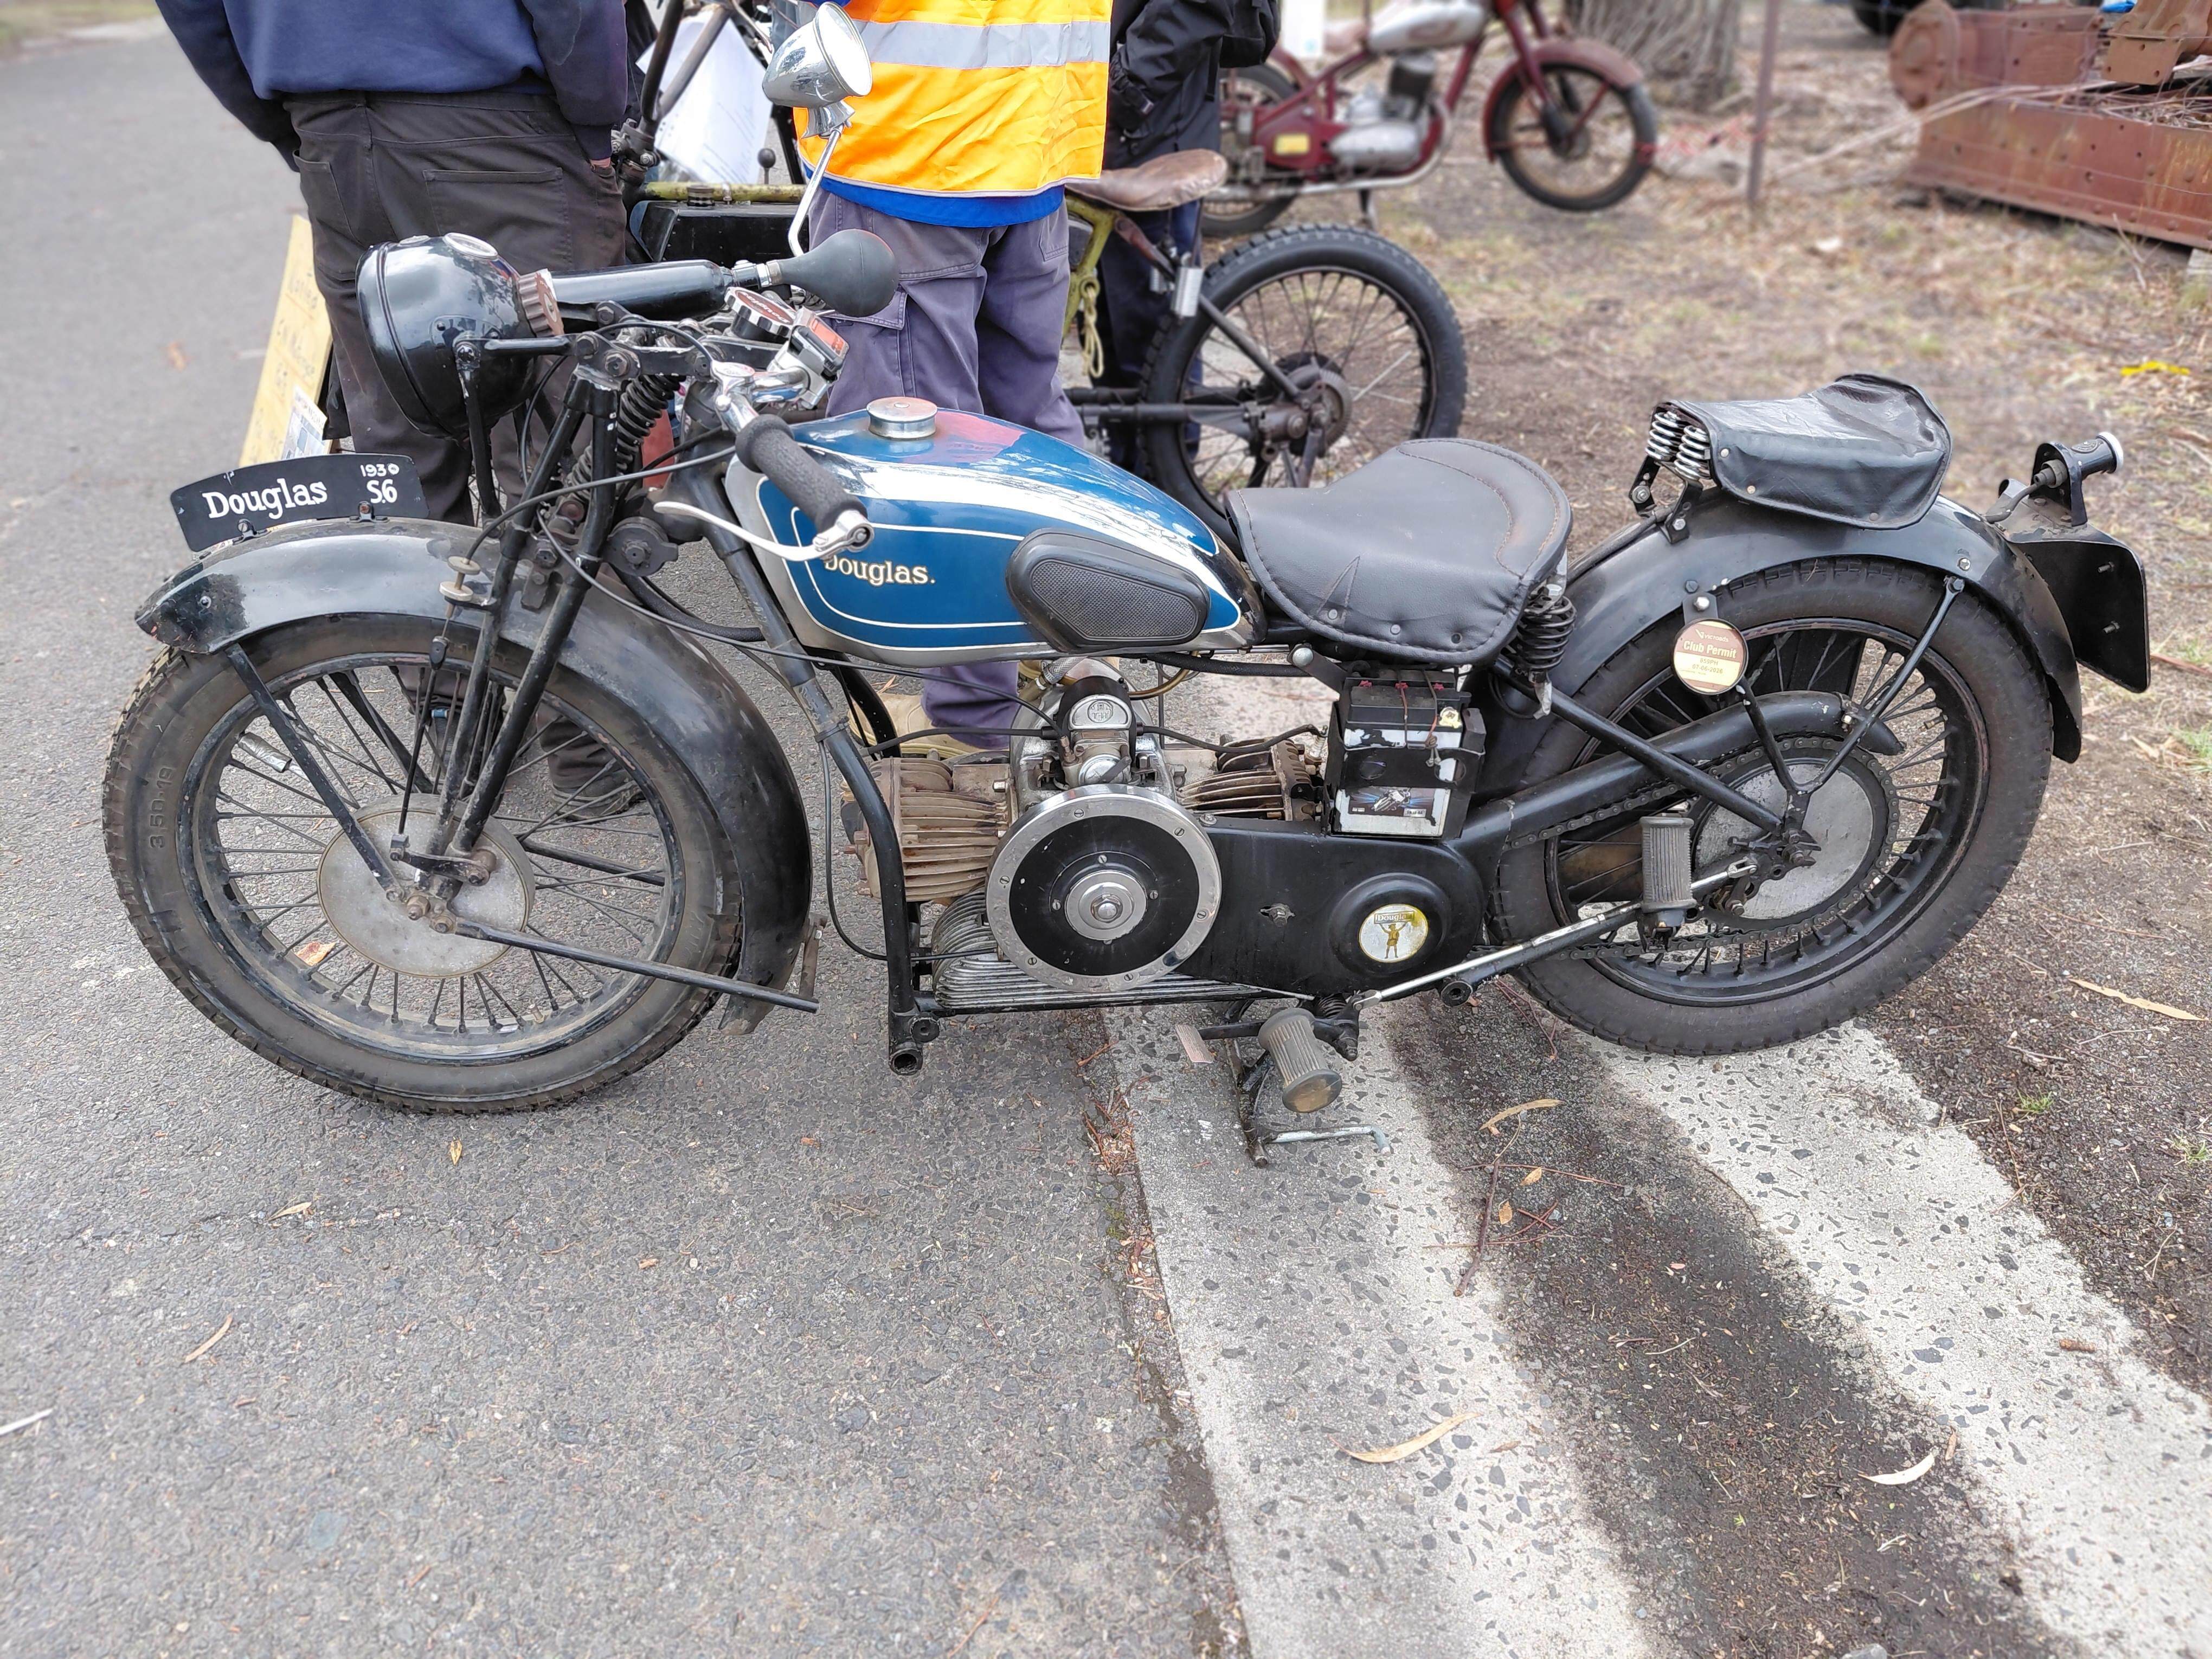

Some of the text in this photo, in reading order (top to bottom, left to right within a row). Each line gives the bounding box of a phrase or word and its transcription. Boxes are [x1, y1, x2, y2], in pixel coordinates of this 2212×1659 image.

[360, 462, 400, 477] 1930
[202, 478, 327, 520] Douglas
[1683, 640, 1737, 659] Club Permit
[1378, 912, 1411, 922] Dougla
